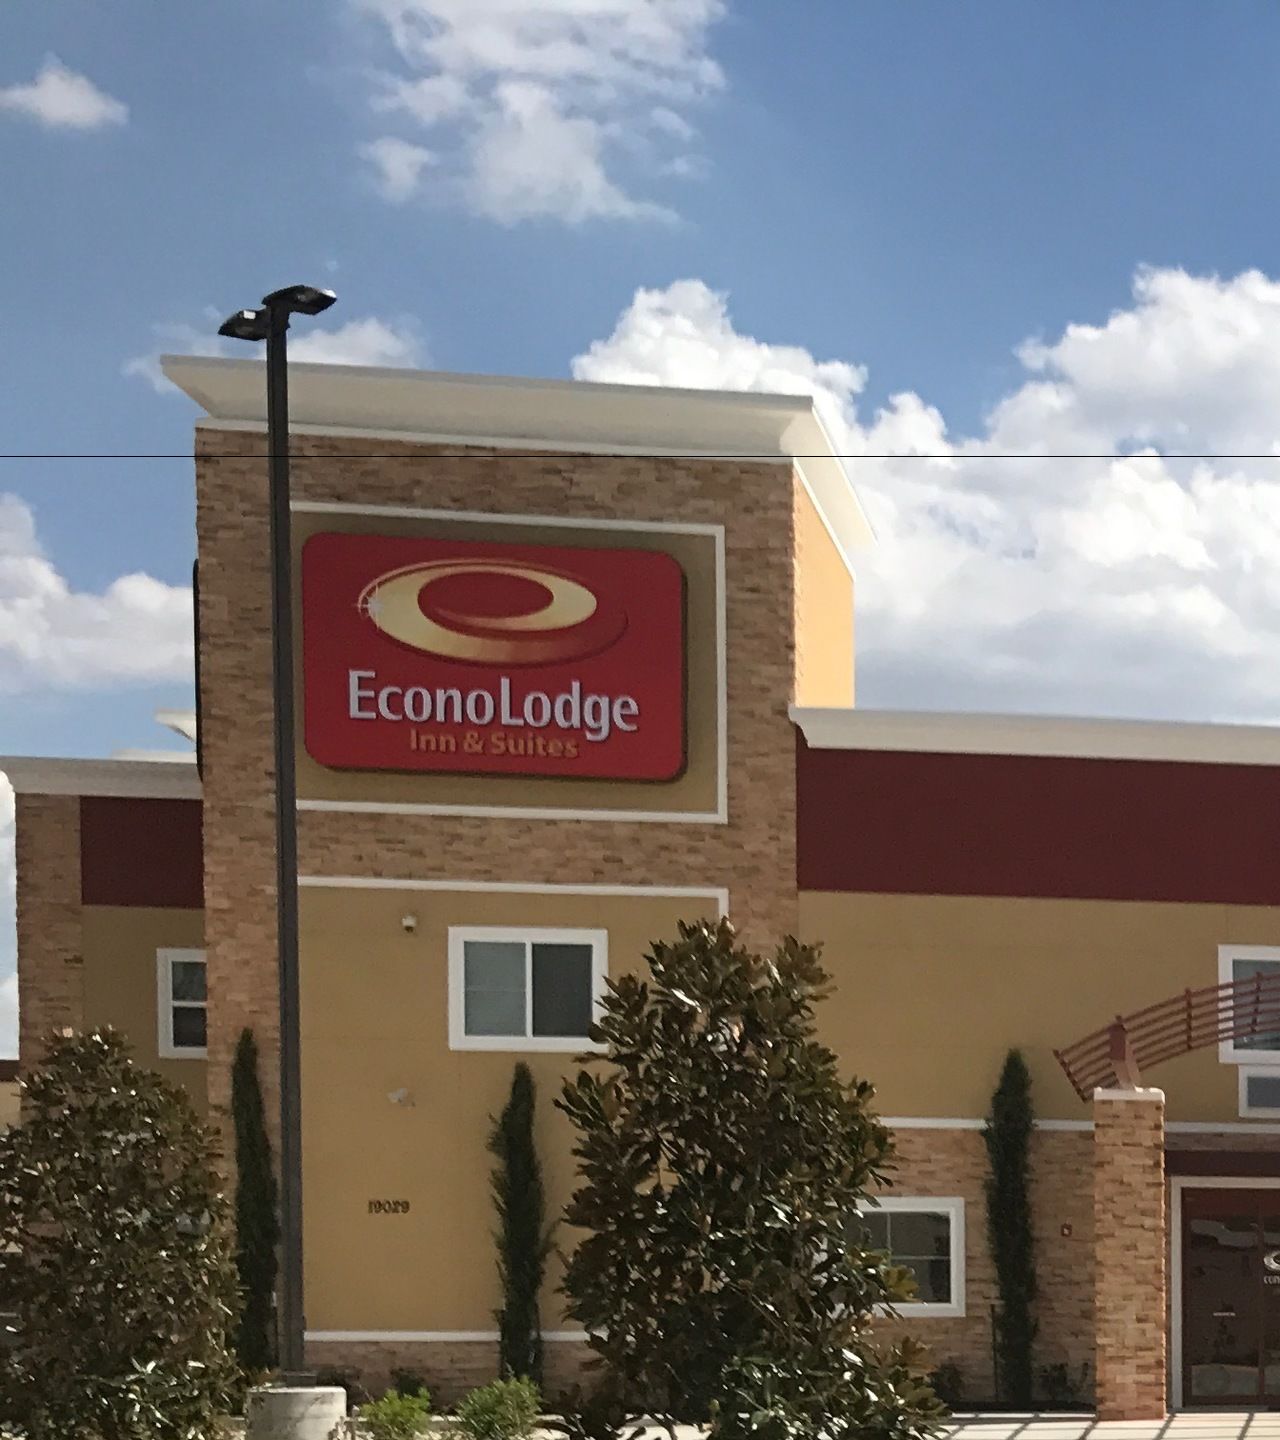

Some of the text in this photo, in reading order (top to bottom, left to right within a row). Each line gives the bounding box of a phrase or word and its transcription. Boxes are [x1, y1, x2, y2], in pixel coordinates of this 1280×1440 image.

[349, 669, 639, 742] EconoLodge
[409, 728, 579, 759] Inn & Suites
